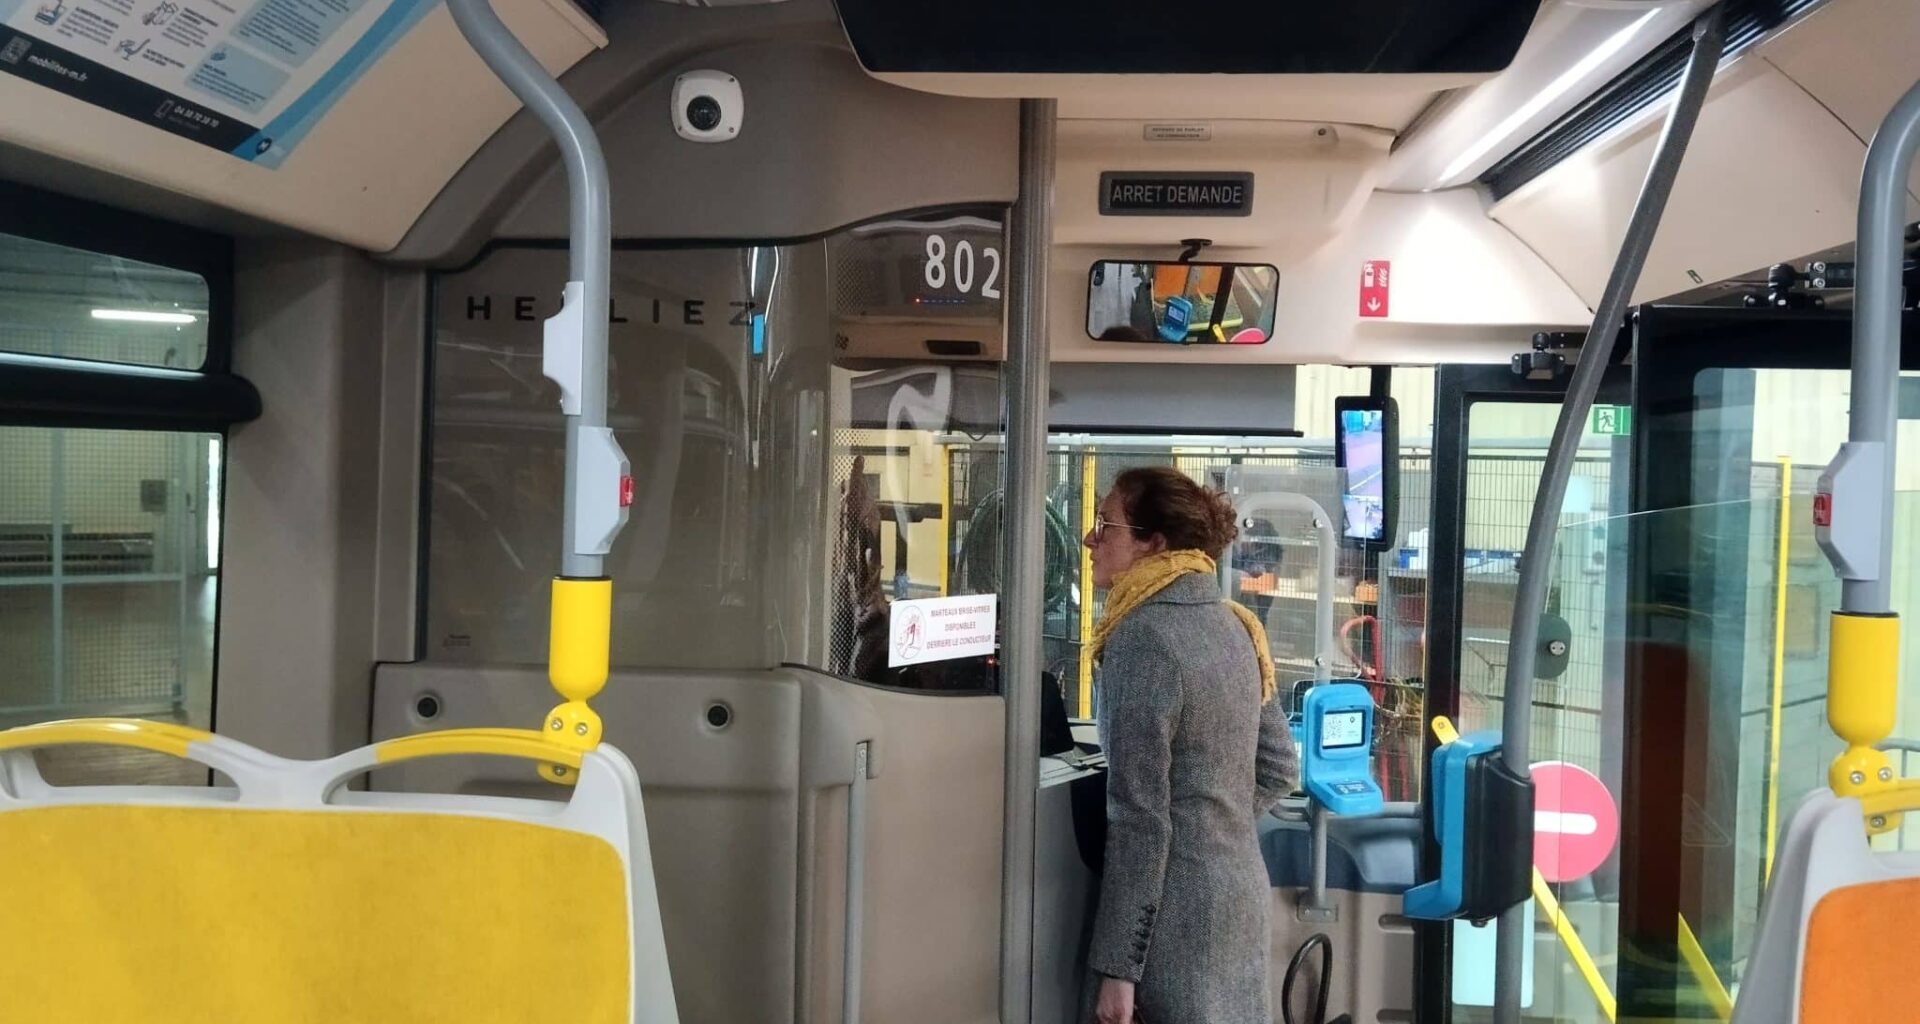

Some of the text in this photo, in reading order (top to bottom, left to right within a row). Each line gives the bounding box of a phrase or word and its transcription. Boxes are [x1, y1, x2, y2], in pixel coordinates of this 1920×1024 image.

[1112, 185, 1242, 203] ARRET DEMANDE
[925, 234, 1001, 299] 802
[466, 296, 757, 326] HELIEZ
